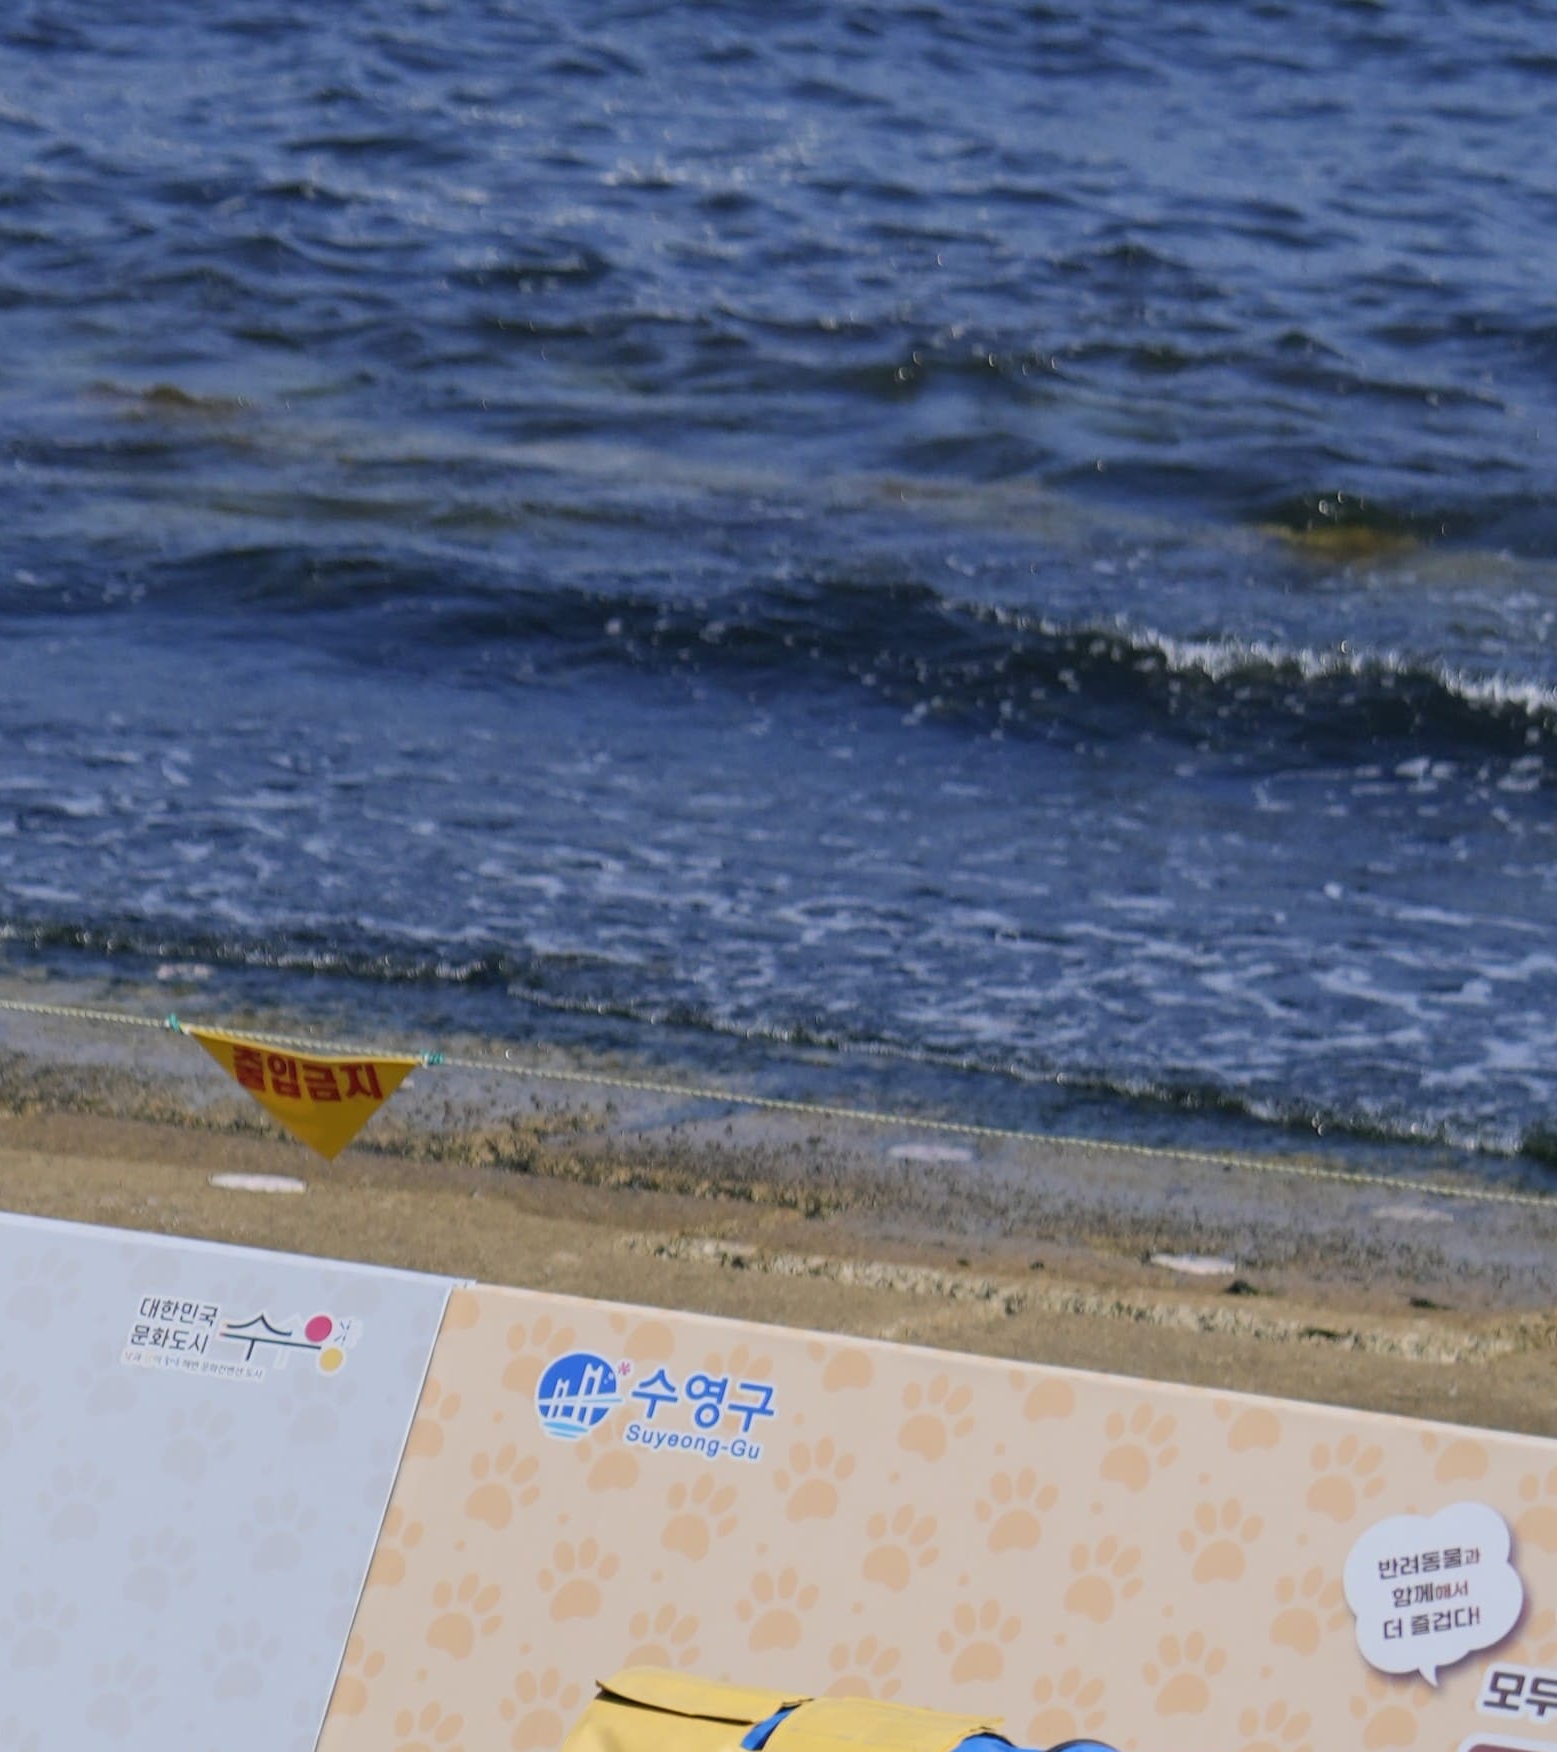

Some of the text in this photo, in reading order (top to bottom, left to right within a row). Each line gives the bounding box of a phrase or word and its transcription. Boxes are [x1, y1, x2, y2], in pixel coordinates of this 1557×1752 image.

[233, 1046, 384, 1102] 출입금지
[140, 1297, 218, 1327] 대한민국
[131, 1325, 209, 1354] 문화도시
[631, 1370, 775, 1433] 수영구
[626, 1425, 762, 1460] Suyeong-Gu
[1378, 1547, 1480, 1580] 반려동물과
[1392, 1580, 1469, 1608] 함께해서
[1383, 1606, 1481, 1639] 더 즐겁다!
